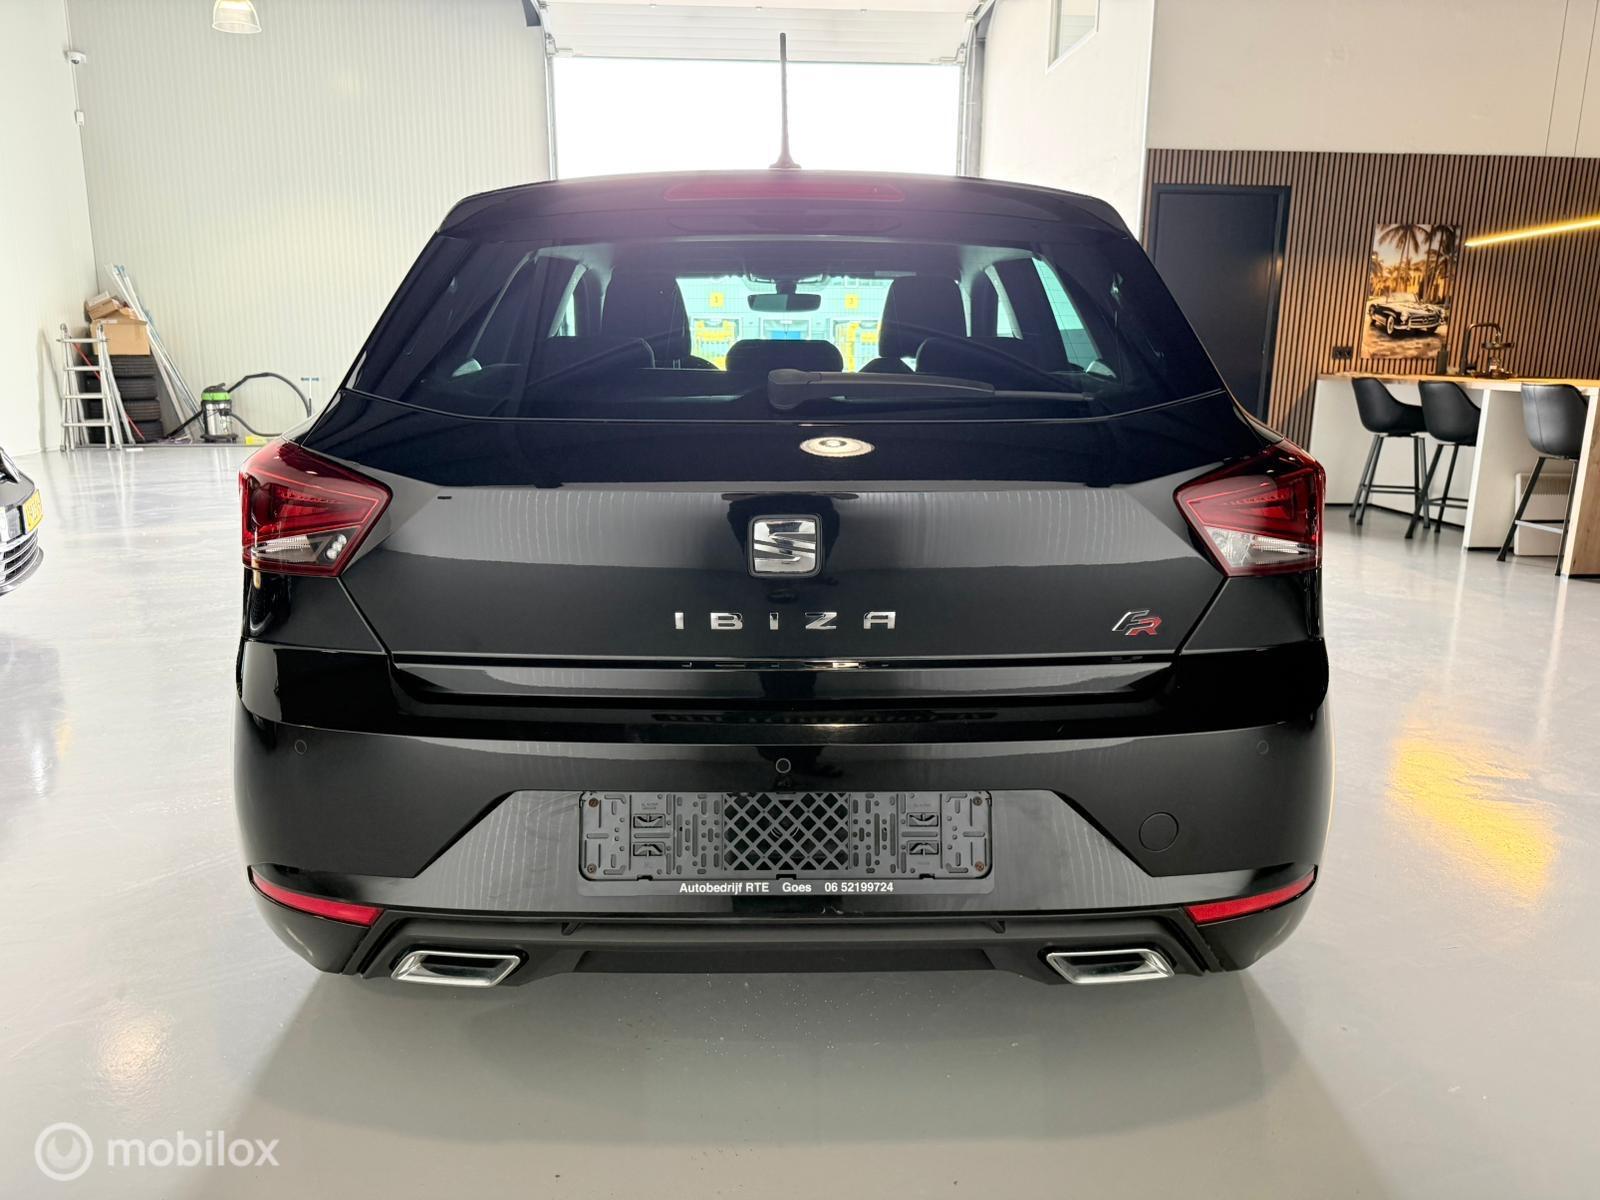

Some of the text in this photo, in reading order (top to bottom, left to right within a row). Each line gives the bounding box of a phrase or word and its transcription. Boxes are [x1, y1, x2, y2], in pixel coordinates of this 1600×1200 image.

[674, 611, 896, 630] IBIZA
[1111, 610, 1162, 636] FR
[679, 881, 894, 895] Autobedrijf RTE Goes 06 52199724
